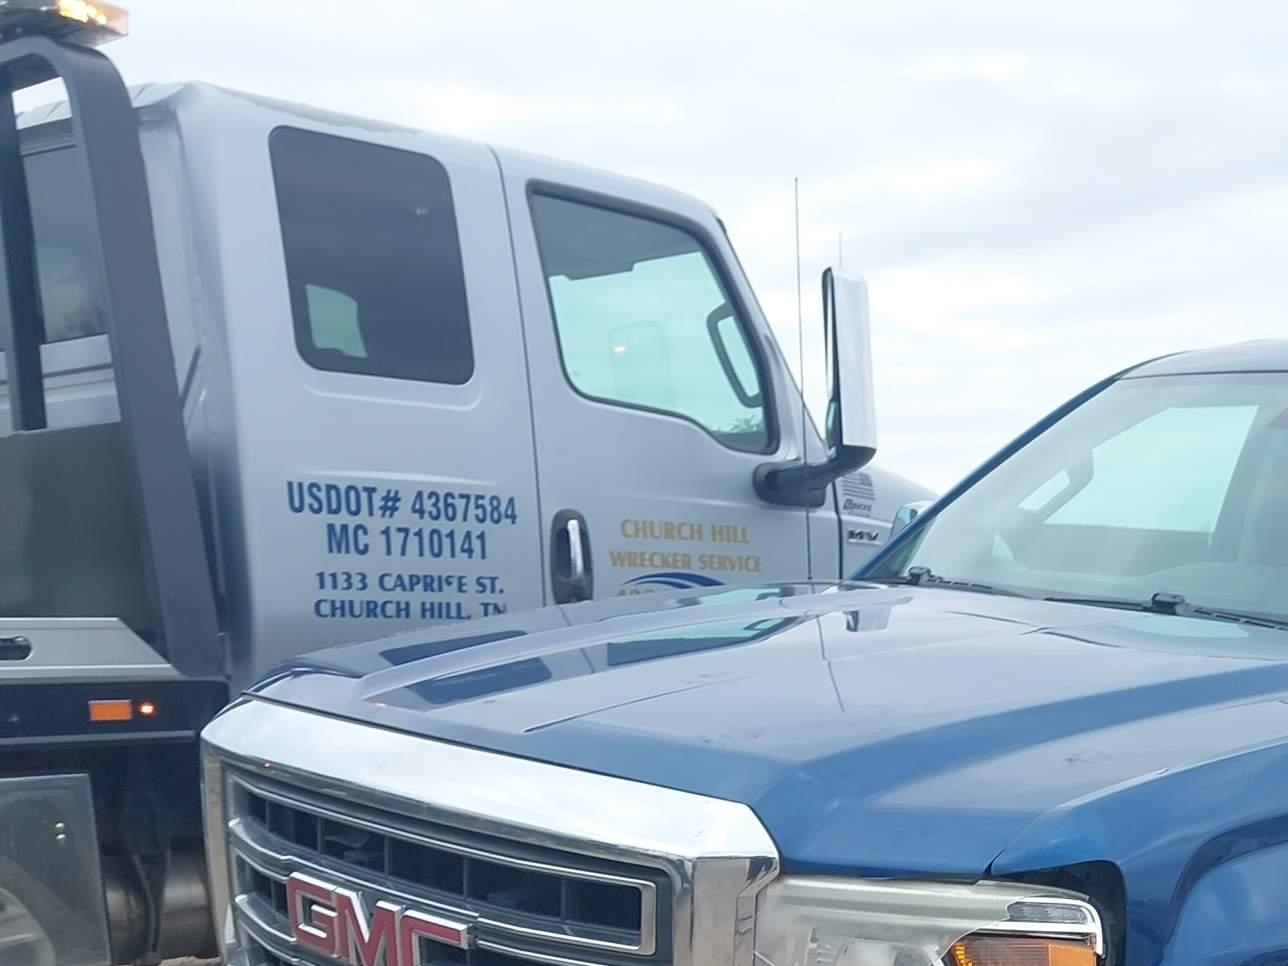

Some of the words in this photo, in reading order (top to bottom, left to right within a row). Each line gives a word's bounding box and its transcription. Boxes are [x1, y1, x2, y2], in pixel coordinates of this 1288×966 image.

[287, 481, 402, 519] USDOT#
[411, 490, 518, 525] 4367584
[326, 523, 370, 556] MC
[381, 526, 487, 560] 1710141
[620, 519, 704, 542] CHURCH
[711, 524, 751, 544] HILL
[610, 551, 693, 570] WRECKER
[698, 554, 762, 573] SERVICE
[316, 571, 368, 591] 1133
[476, 576, 505, 595] ST.
[314, 599, 411, 619] CHURCH
